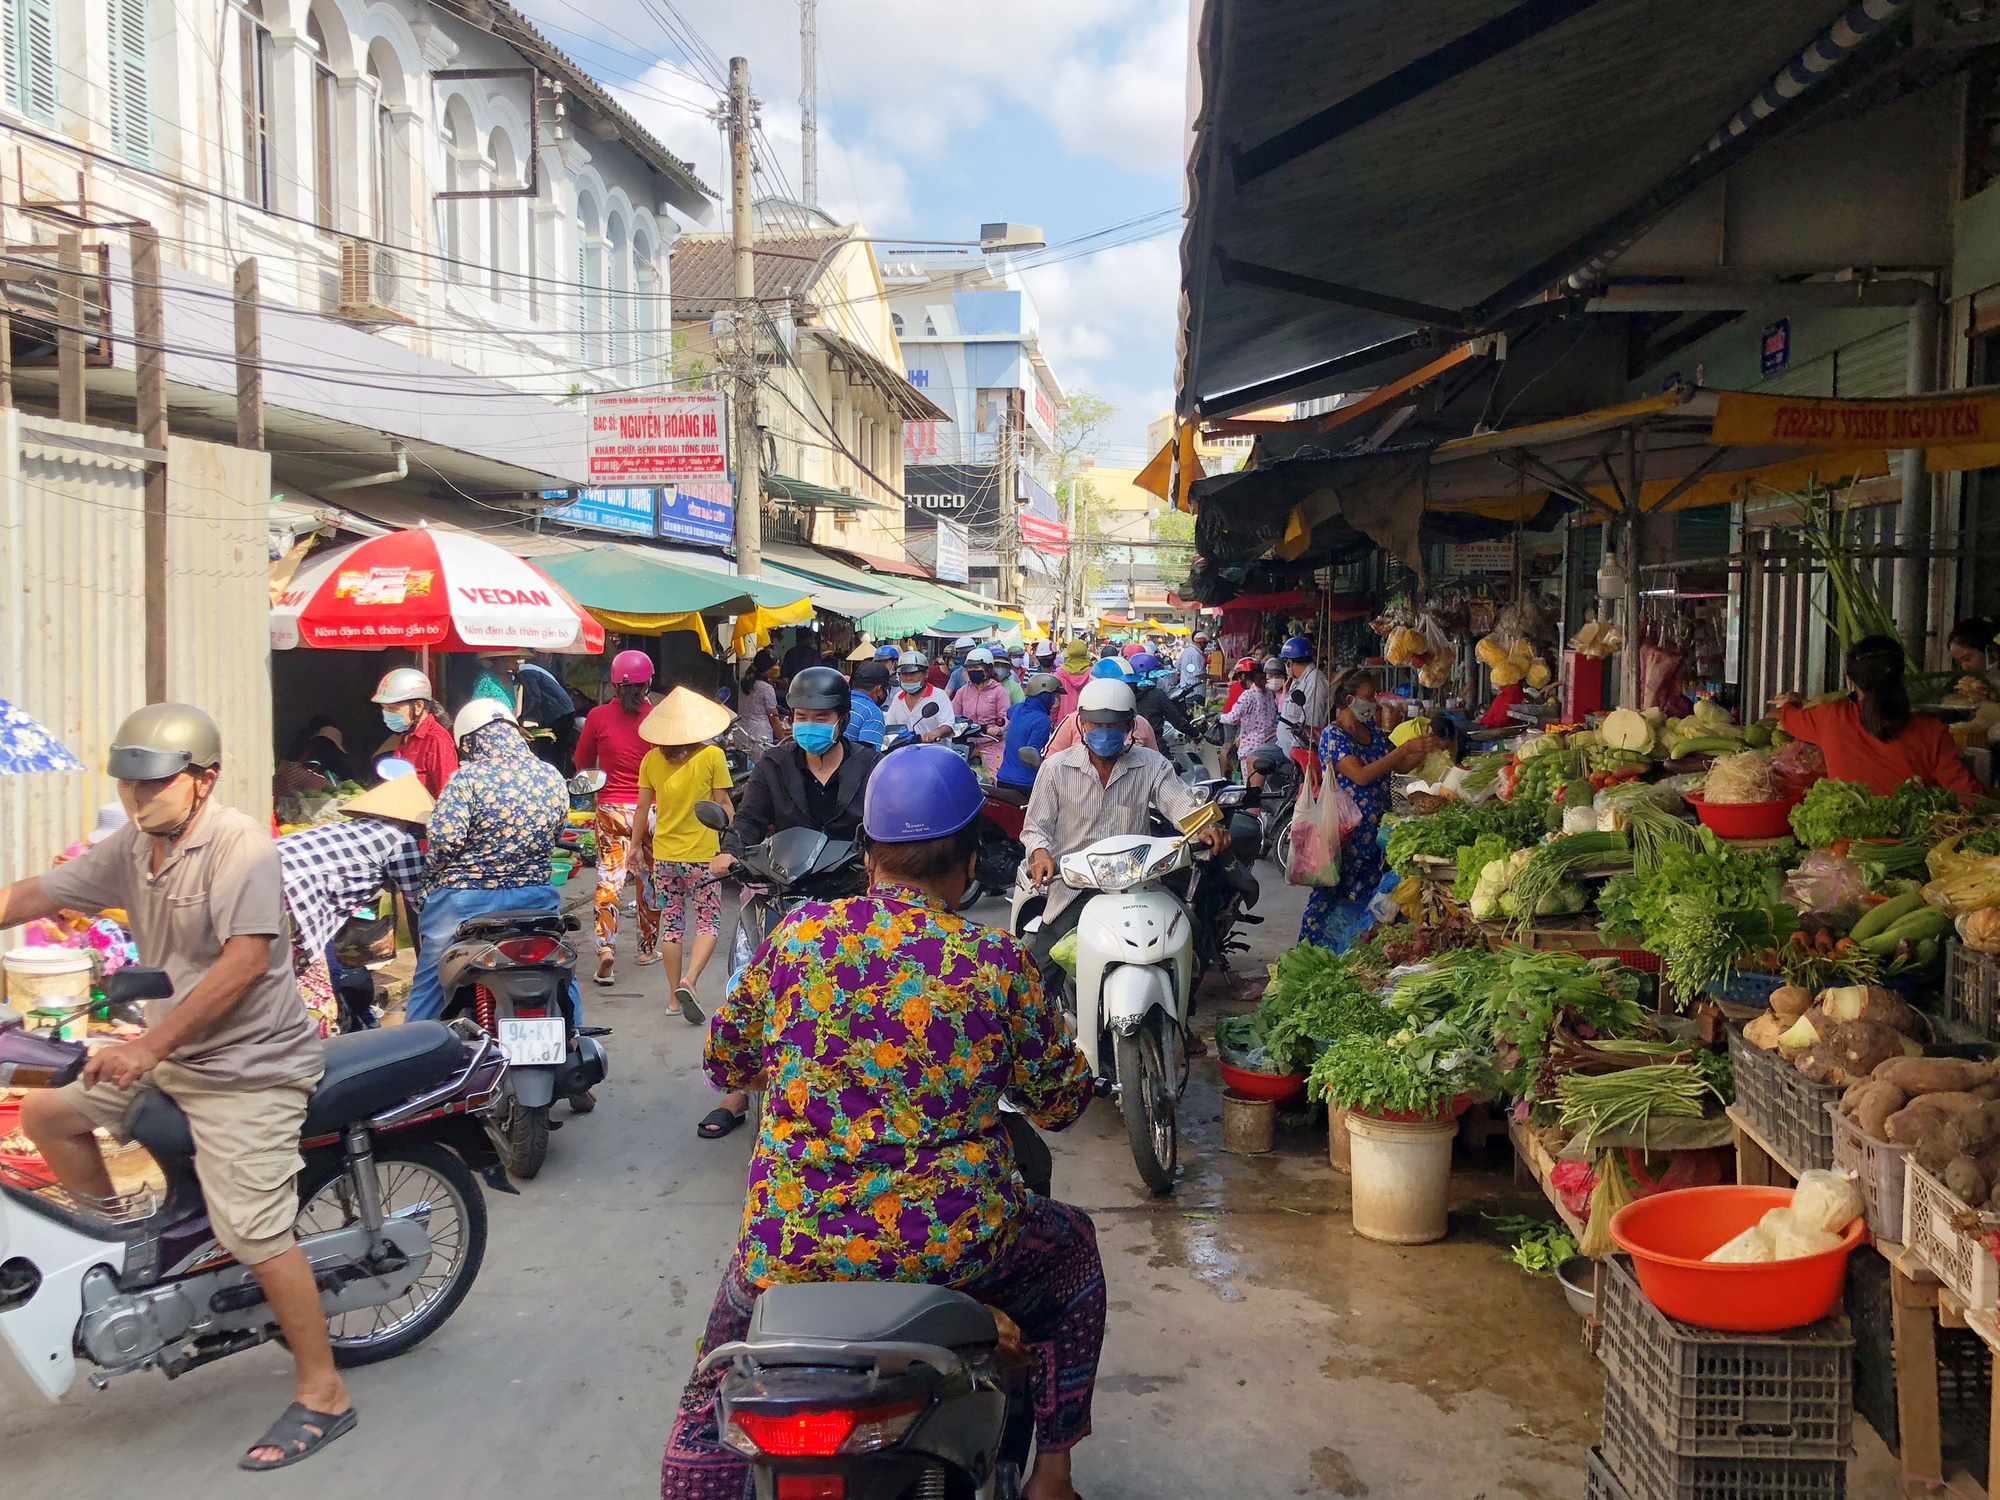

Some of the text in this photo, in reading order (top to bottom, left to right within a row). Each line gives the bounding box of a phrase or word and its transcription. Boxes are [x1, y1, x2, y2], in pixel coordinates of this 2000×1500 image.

[907, 369, 929, 388] HH
[593, 413, 607, 431] BÁC
[620, 406, 661, 439] NGUYỄN
[664, 409, 700, 438] HOÀNG
[703, 409, 717, 438] HÀ
[595, 444, 616, 455] KHÁM
[658, 445, 680, 456] NGOẠI
[681, 441, 700, 454] TỔNG
[701, 443, 720, 454] QUÁT
[276, 591, 310, 607] DAN
[458, 587, 552, 607] VEDAN
[315, 627, 337, 638] Nêm
[339, 626, 360, 639] đậm
[378, 624, 404, 635] thêm
[406, 623, 425, 638] gắn
[427, 624, 440, 635] bó
[464, 625, 483, 635] Nêm
[485, 625, 503, 637] đậm
[520, 626, 540, 637] thêm
[541, 626, 557, 639] gắn
[558, 629, 569, 638] bó
[509, 1022, 554, 1041] 94-K1
[506, 1041, 562, 1062] 14.87
